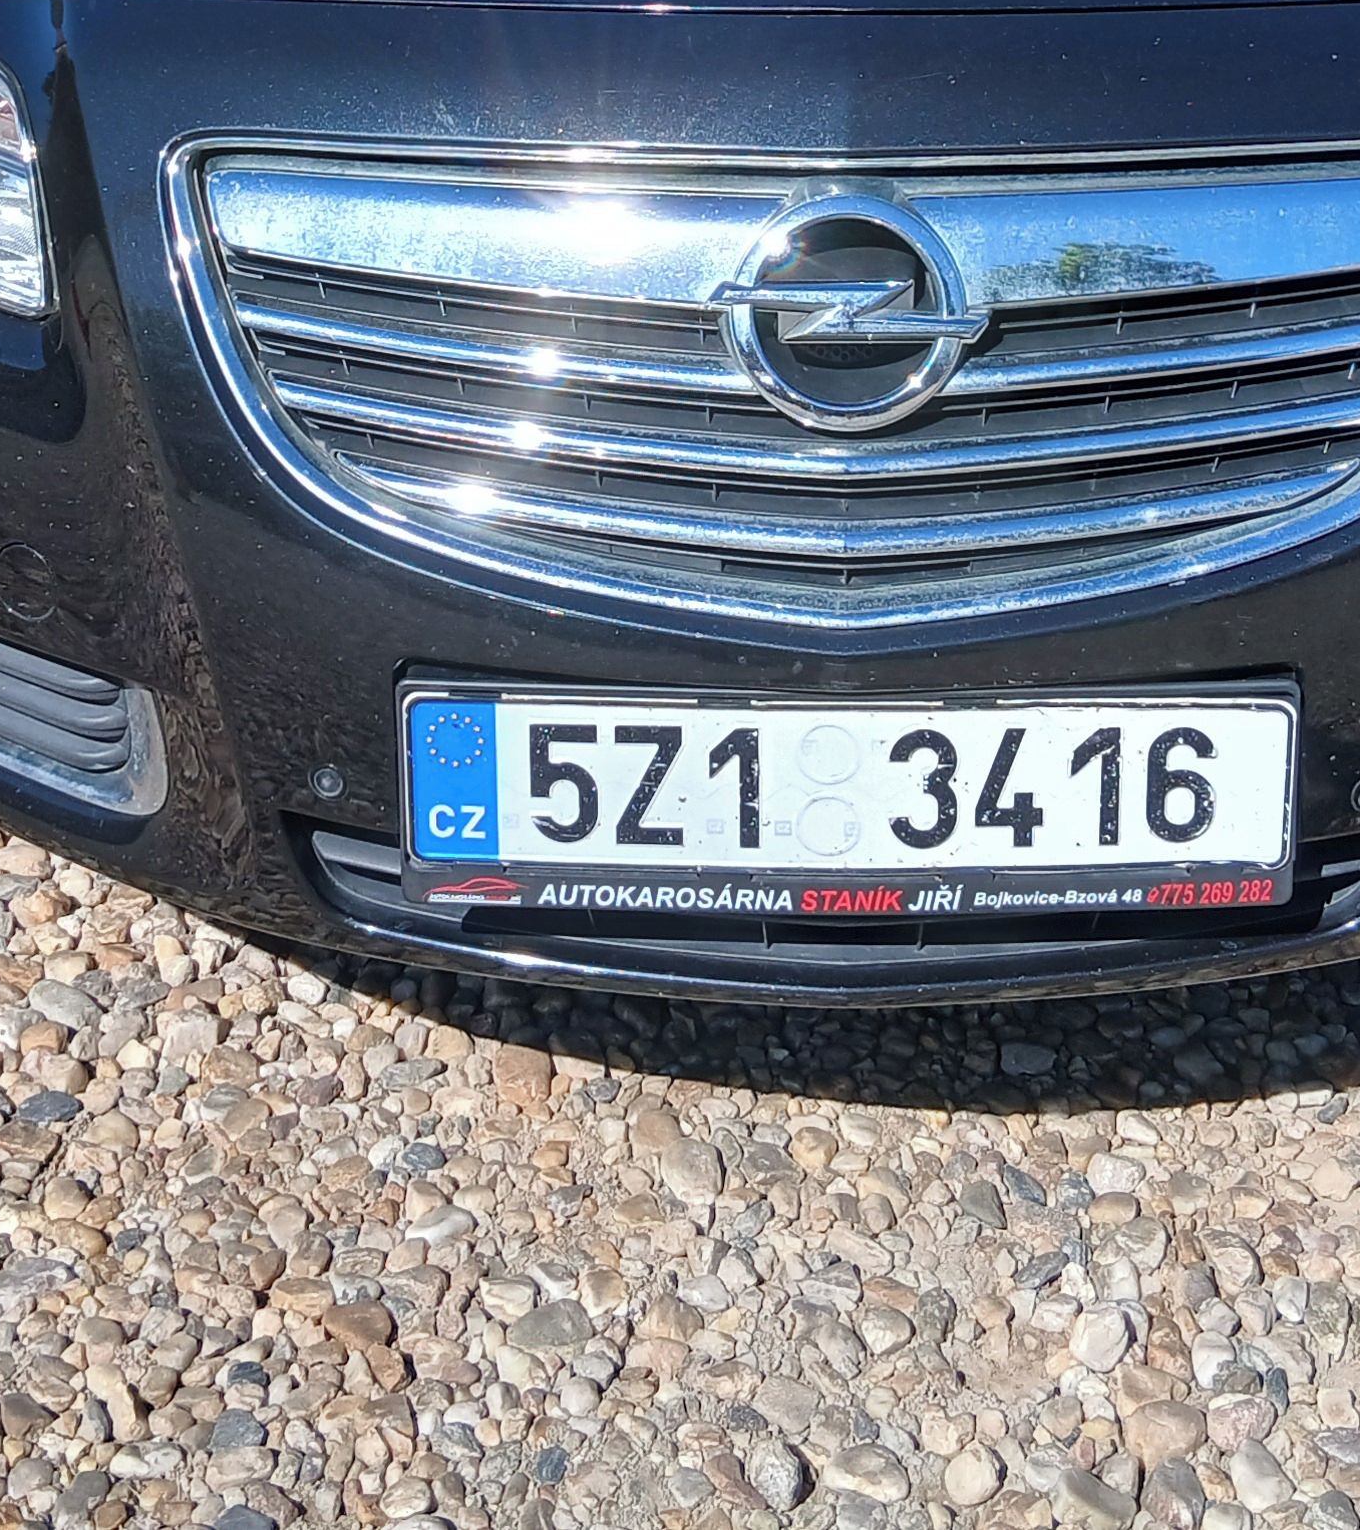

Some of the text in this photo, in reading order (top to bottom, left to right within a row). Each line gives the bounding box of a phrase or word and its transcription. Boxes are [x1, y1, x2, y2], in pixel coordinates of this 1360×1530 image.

[529, 723, 1218, 849] 5Z1 3416
[428, 804, 486, 839] CZ
[537, 882, 794, 911] AUTOKAROSÁRNA
[800, 885, 903, 912] STANÍK
[908, 884, 963, 912] JIŘÍ
[973, 888, 1118, 910] Bojkovice-Bzová
[1121, 888, 1143, 903] 48
[1160, 882, 1194, 908] 775
[1199, 881, 1234, 905] 269
[1239, 879, 1274, 903] 282
